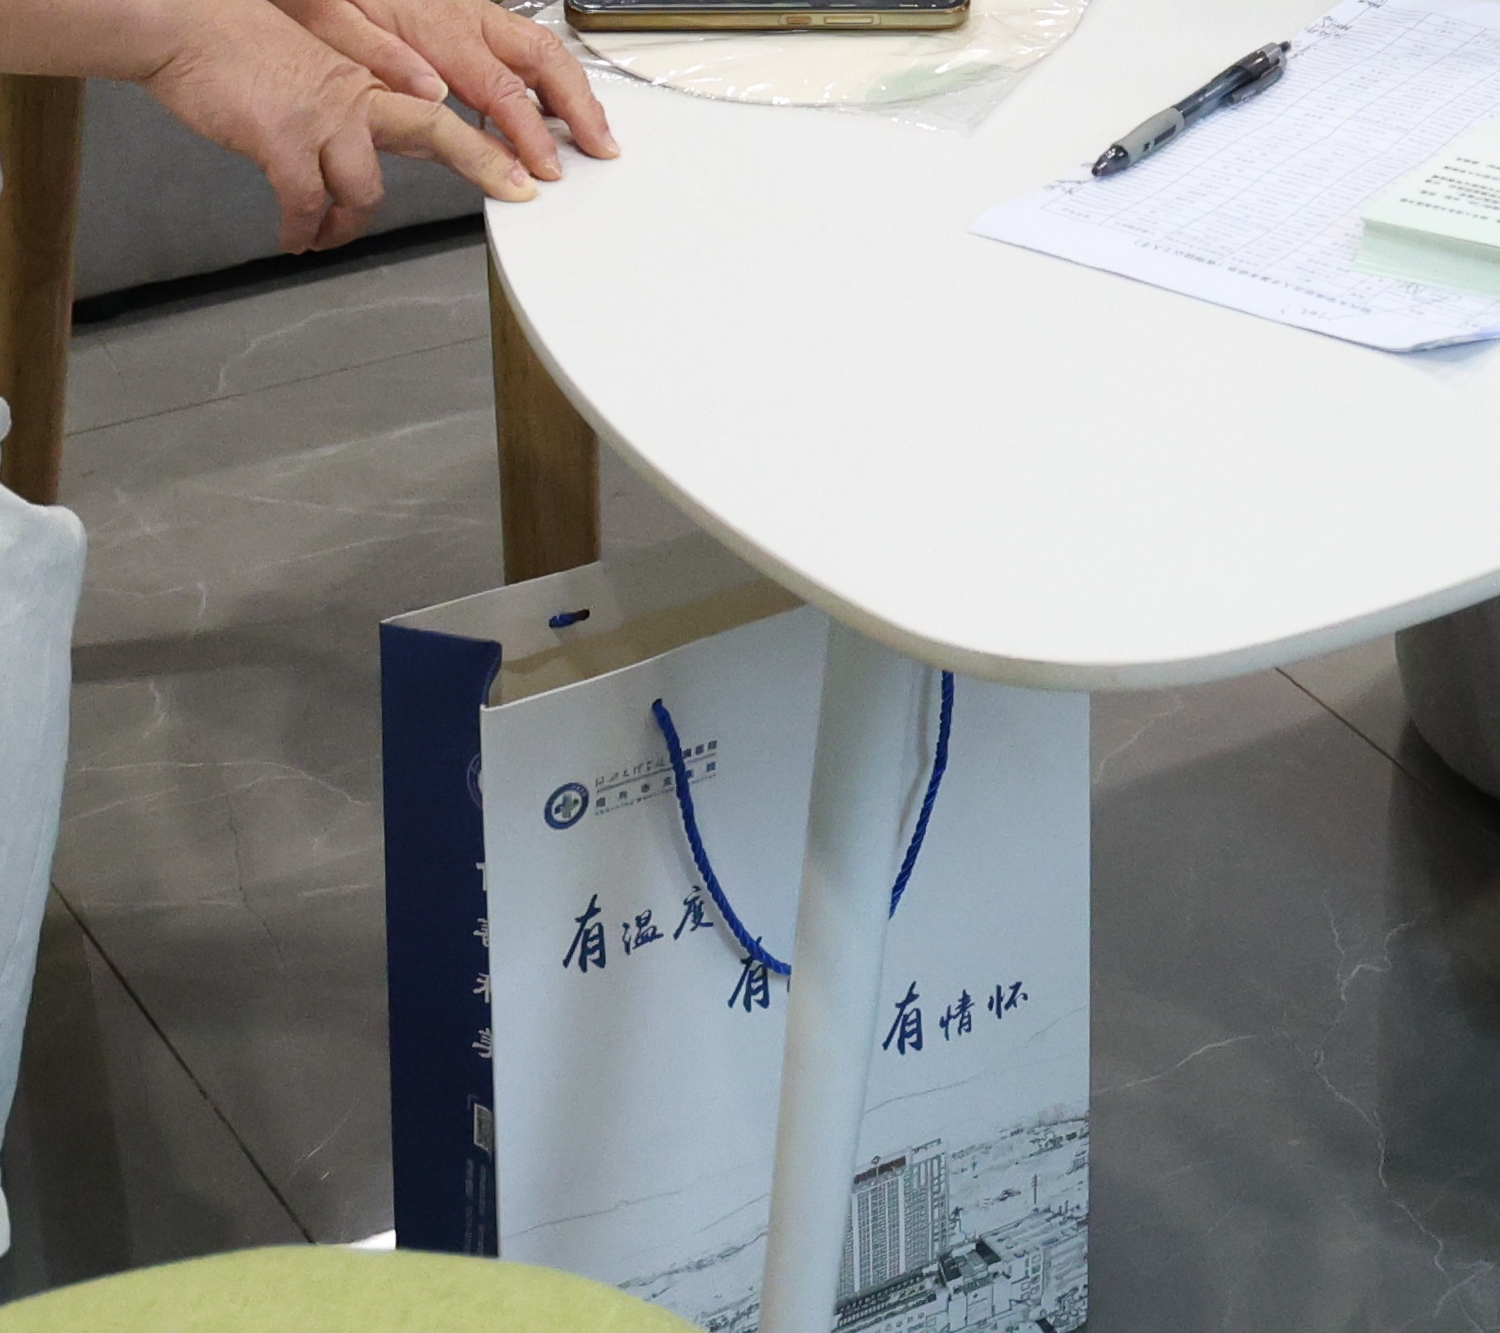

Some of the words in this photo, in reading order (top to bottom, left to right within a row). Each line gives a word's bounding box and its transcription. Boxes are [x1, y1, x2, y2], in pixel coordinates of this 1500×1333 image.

[562, 885, 714, 974] 有温度
[881, 980, 1029, 1056] 有情怀
